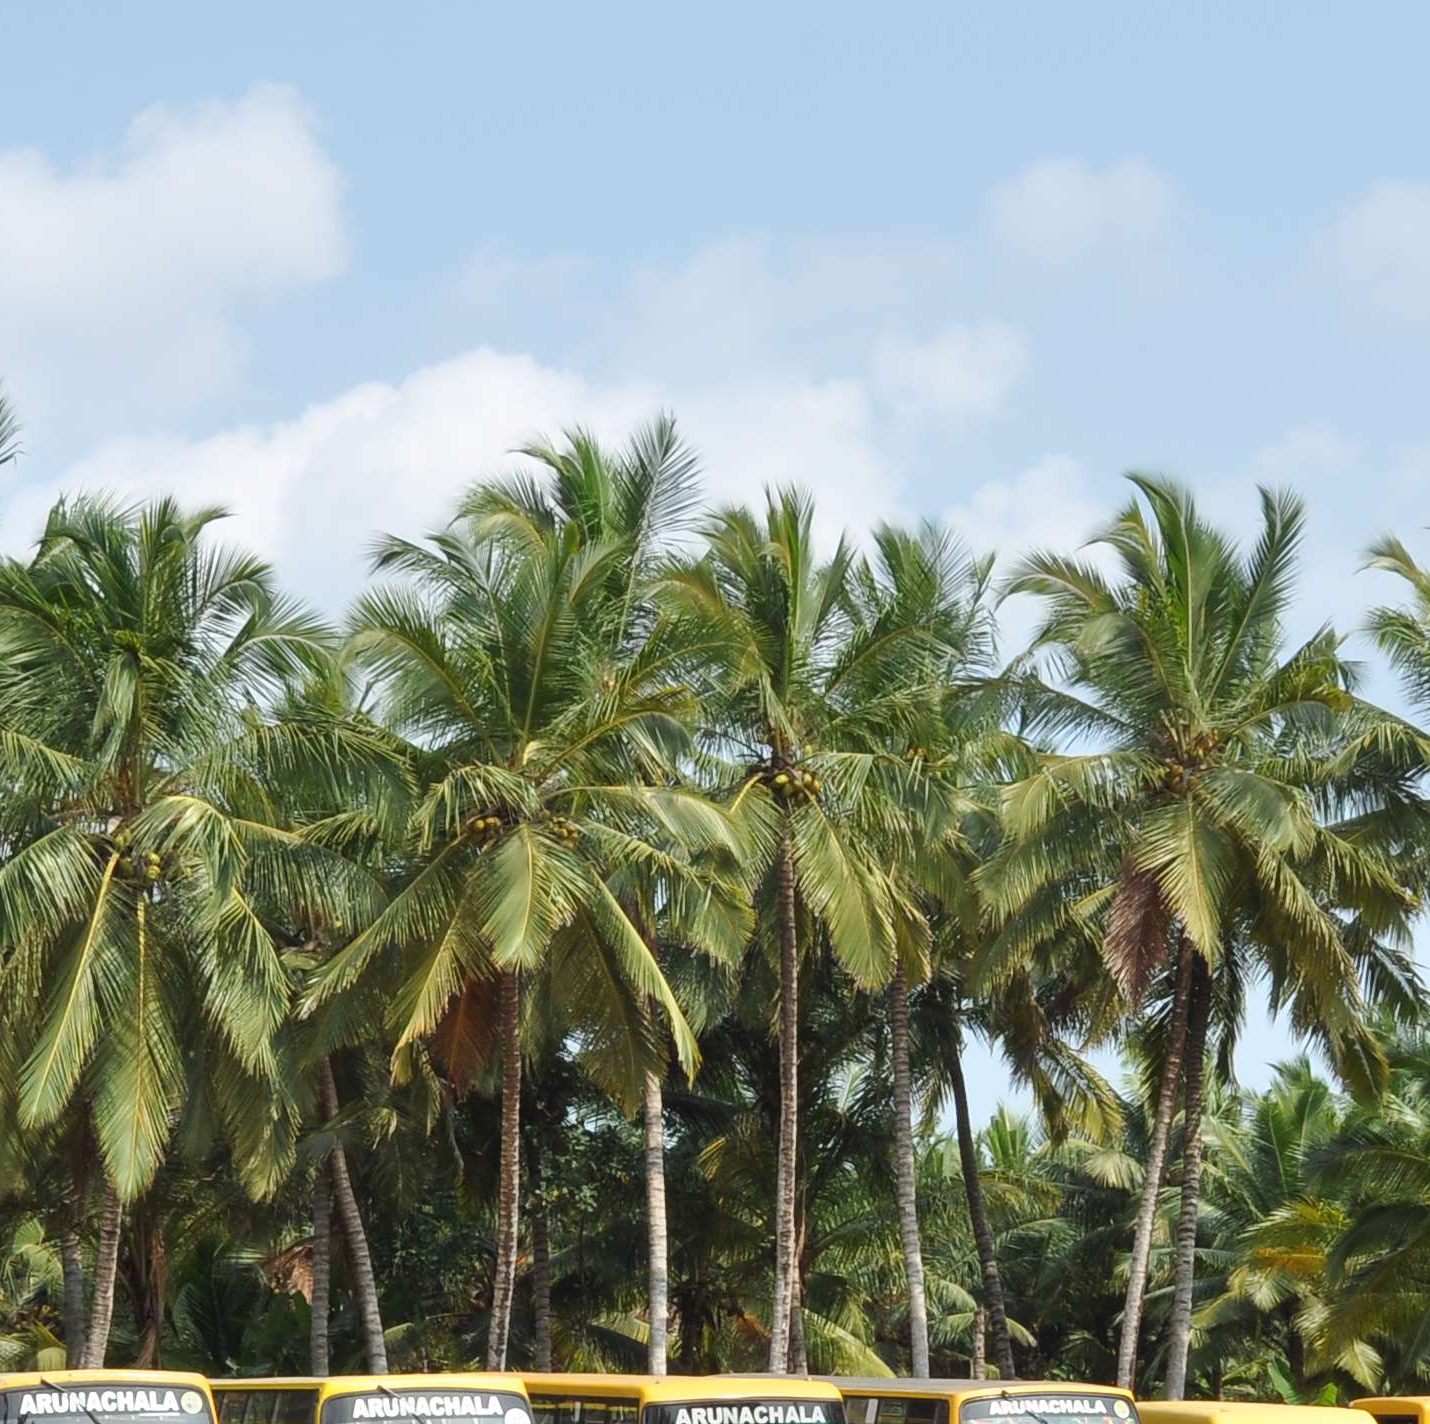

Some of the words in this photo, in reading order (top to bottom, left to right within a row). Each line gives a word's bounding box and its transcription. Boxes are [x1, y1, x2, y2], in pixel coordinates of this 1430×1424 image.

[20, 1391, 179, 1415] ARUNACHALA
[353, 1395, 503, 1418] ARUNACHALA
[990, 1400, 1107, 1416] ARUNACHALA
